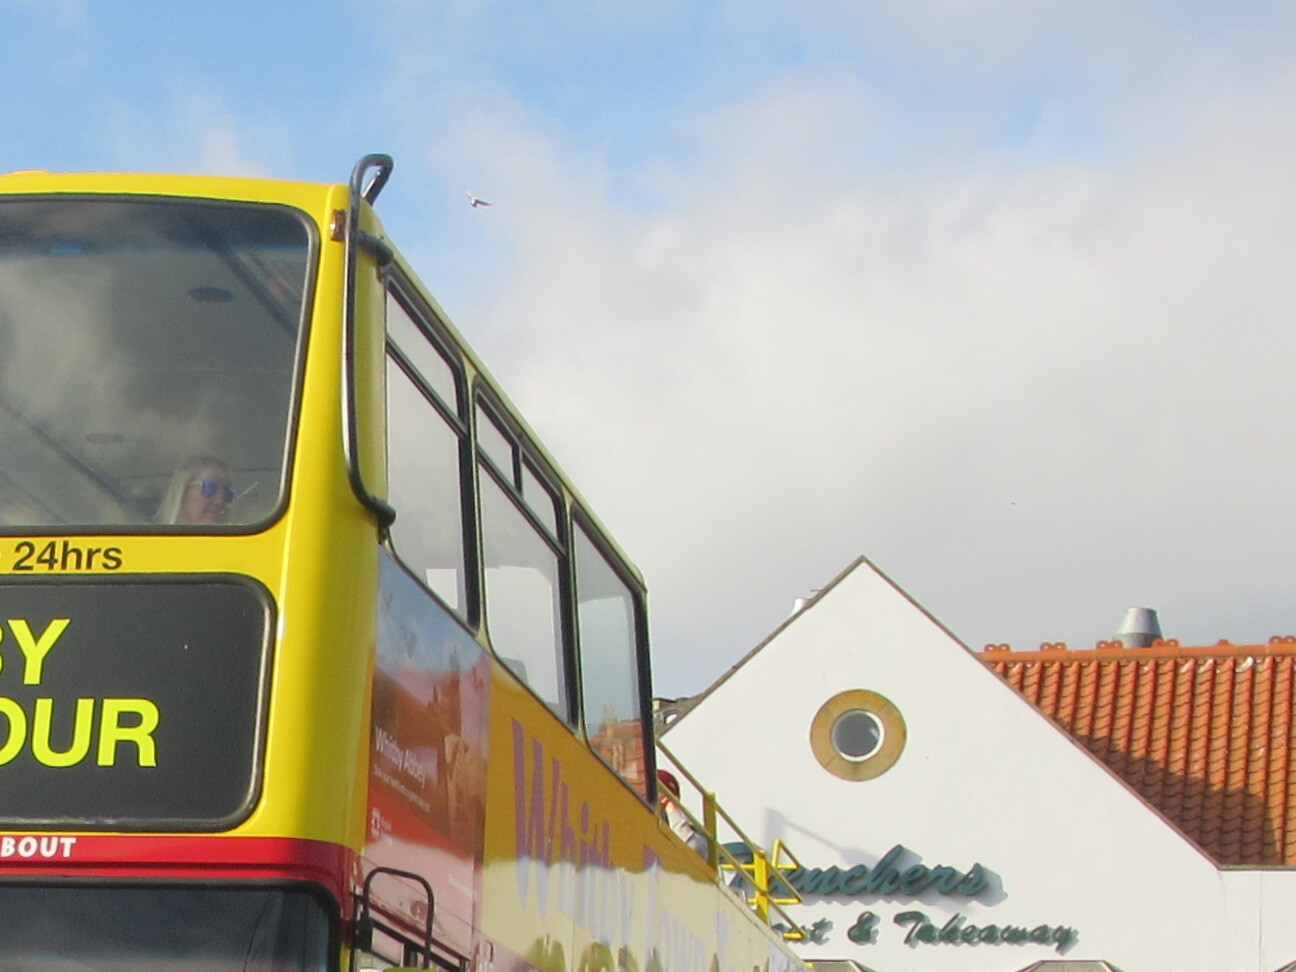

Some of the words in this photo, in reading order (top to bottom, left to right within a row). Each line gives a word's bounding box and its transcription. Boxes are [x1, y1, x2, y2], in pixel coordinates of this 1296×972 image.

[12, 540, 124, 572] 24hrs
[847, 910, 878, 945] &
[893, 910, 1079, 956] Takeaway
